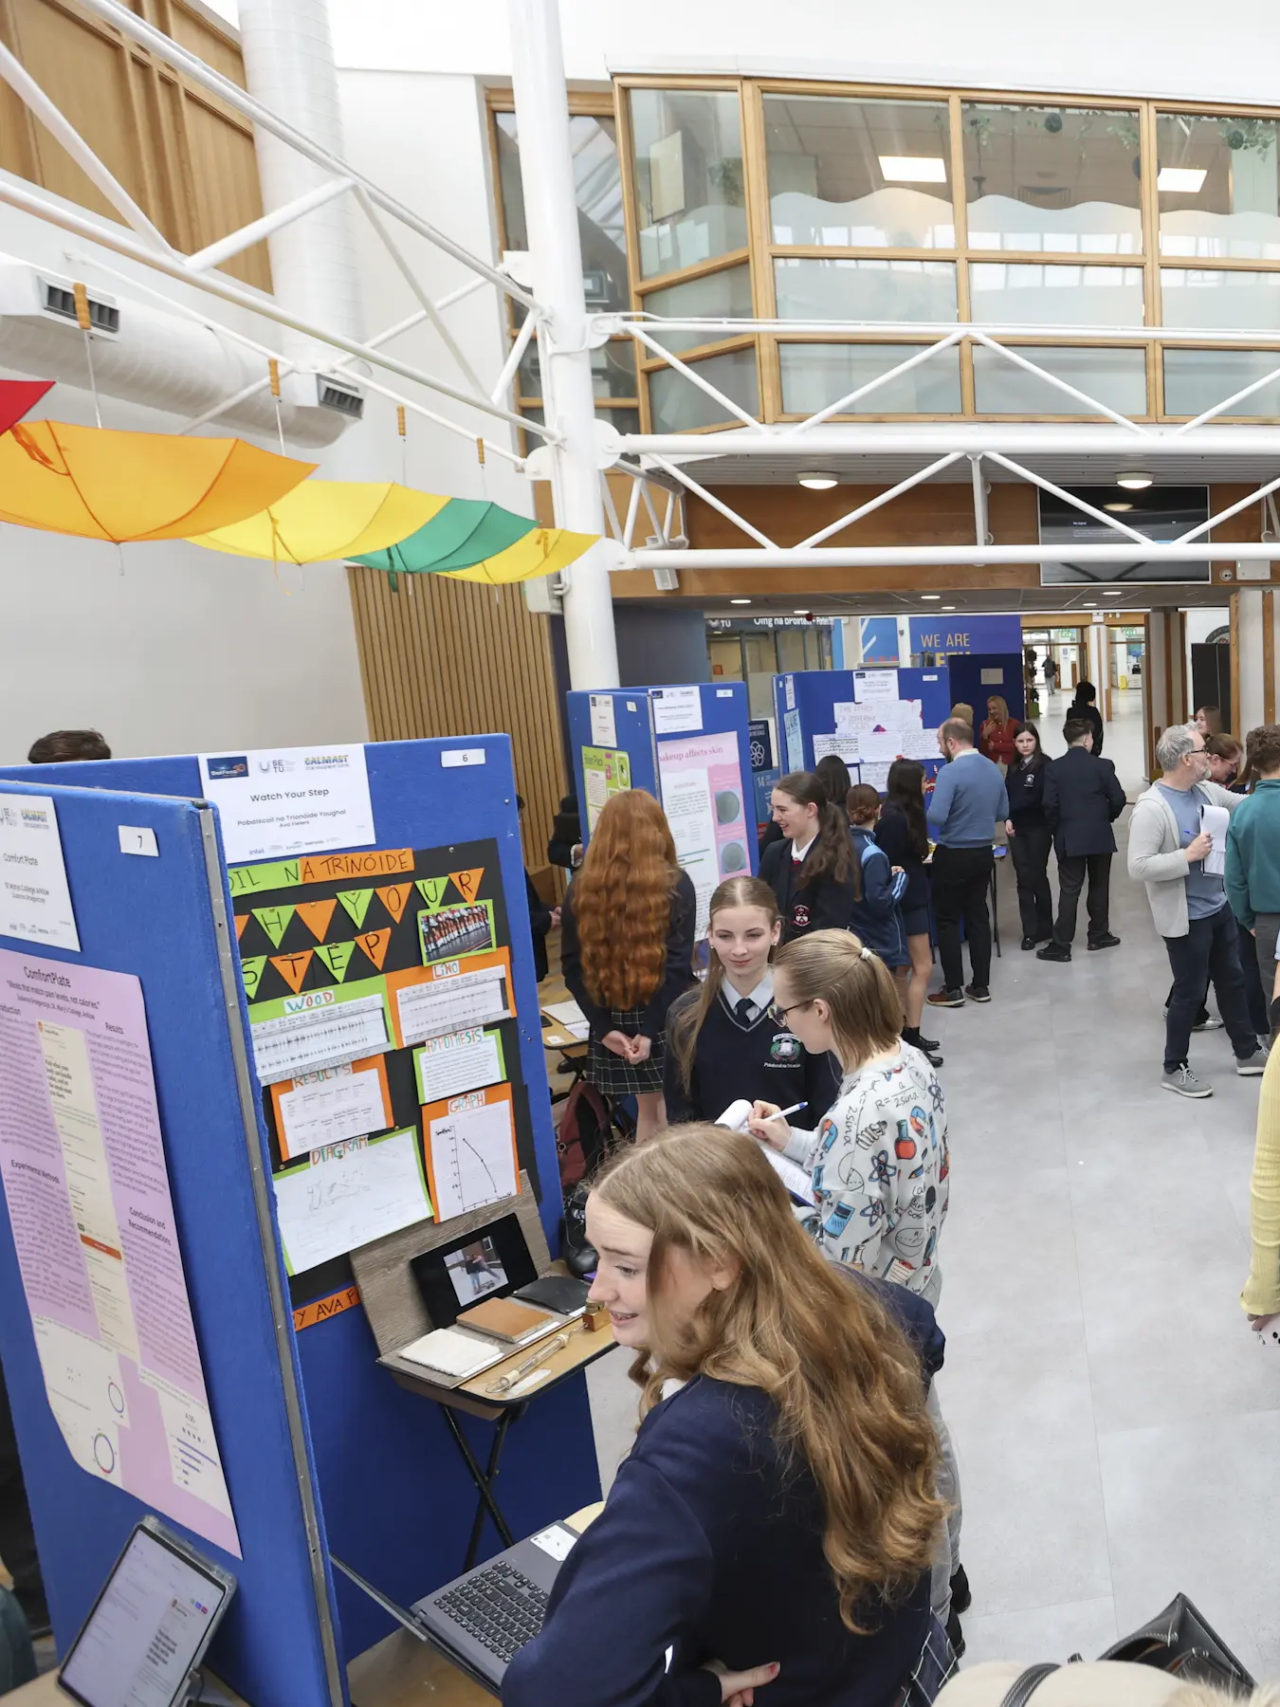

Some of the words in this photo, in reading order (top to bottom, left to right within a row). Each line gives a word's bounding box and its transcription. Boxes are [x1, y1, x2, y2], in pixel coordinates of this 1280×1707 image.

[920, 634, 941, 648] WE
[946, 633, 970, 647] ARE
[462, 753, 469, 763] 6
[685, 749, 707, 759] affects
[707, 746, 724, 756] skin
[272, 759, 284, 767] SE
[304, 755, 349, 766] CALMAST
[250, 791, 283, 803] Watch
[284, 791, 306, 800] Your
[308, 788, 330, 797] Step
[237, 815, 275, 827] Pobalscoil
[319, 809, 347, 818] Youghal
[137, 835, 143, 849] 7
[24, 856, 39, 867] Plate
[284, 861, 315, 883] NA
[23, 966, 72, 988] ComfortPlate
[286, 991, 334, 1012] WOOD
[105, 1022, 125, 1035] Results
[293, 1064, 352, 1089] RESULTS
[450, 1092, 484, 1113] GRAPH
[311, 1136, 368, 1165] DIAGRAM
[316, 1299, 344, 1321] AVA
